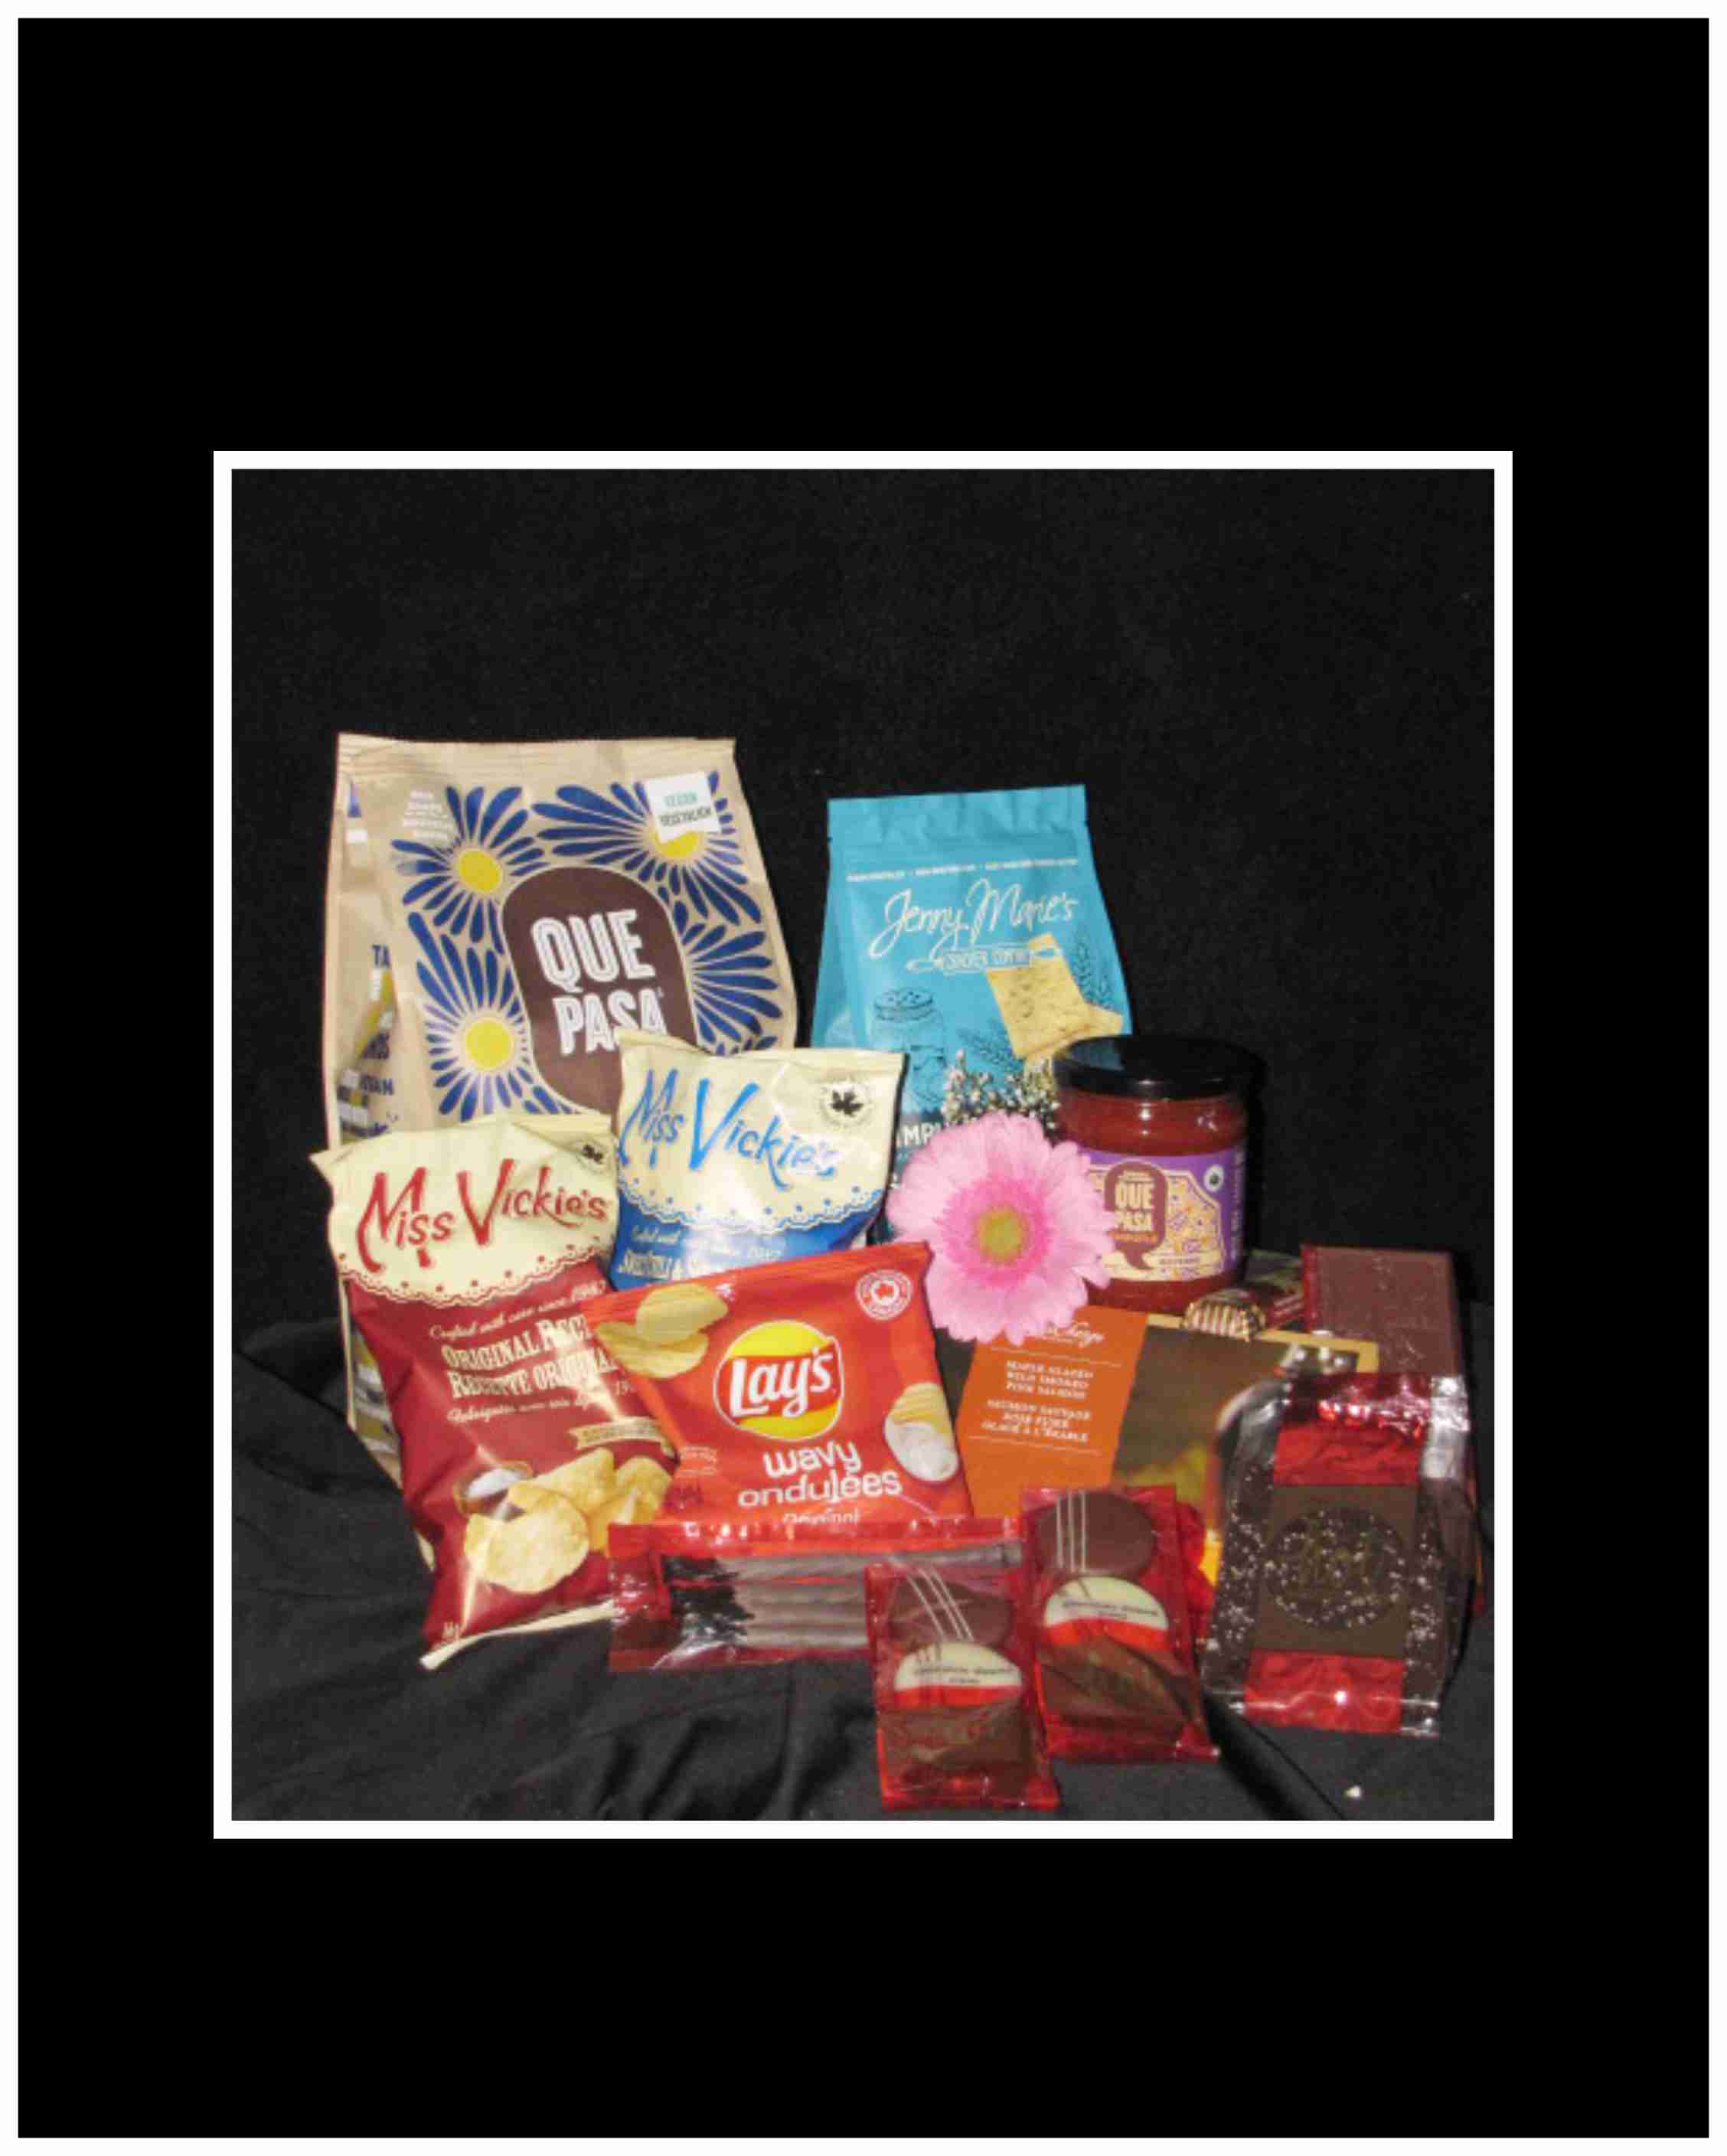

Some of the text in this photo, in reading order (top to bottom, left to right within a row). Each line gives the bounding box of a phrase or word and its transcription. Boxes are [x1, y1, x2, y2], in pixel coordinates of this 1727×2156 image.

[531, 909, 657, 995] QUE
[868, 878, 1078, 960] Jenny Marie's
[552, 989, 668, 1056] PASA
[618, 1069, 684, 1170] Miss
[688, 1077, 840, 1191] Vickie's
[357, 1158, 608, 1274] Miss Vickie's
[1115, 1183, 1154, 1210] QUE
[729, 1345, 834, 1419] Lay's
[737, 1468, 903, 1508] ondulées
[762, 1440, 863, 1478] wavy
